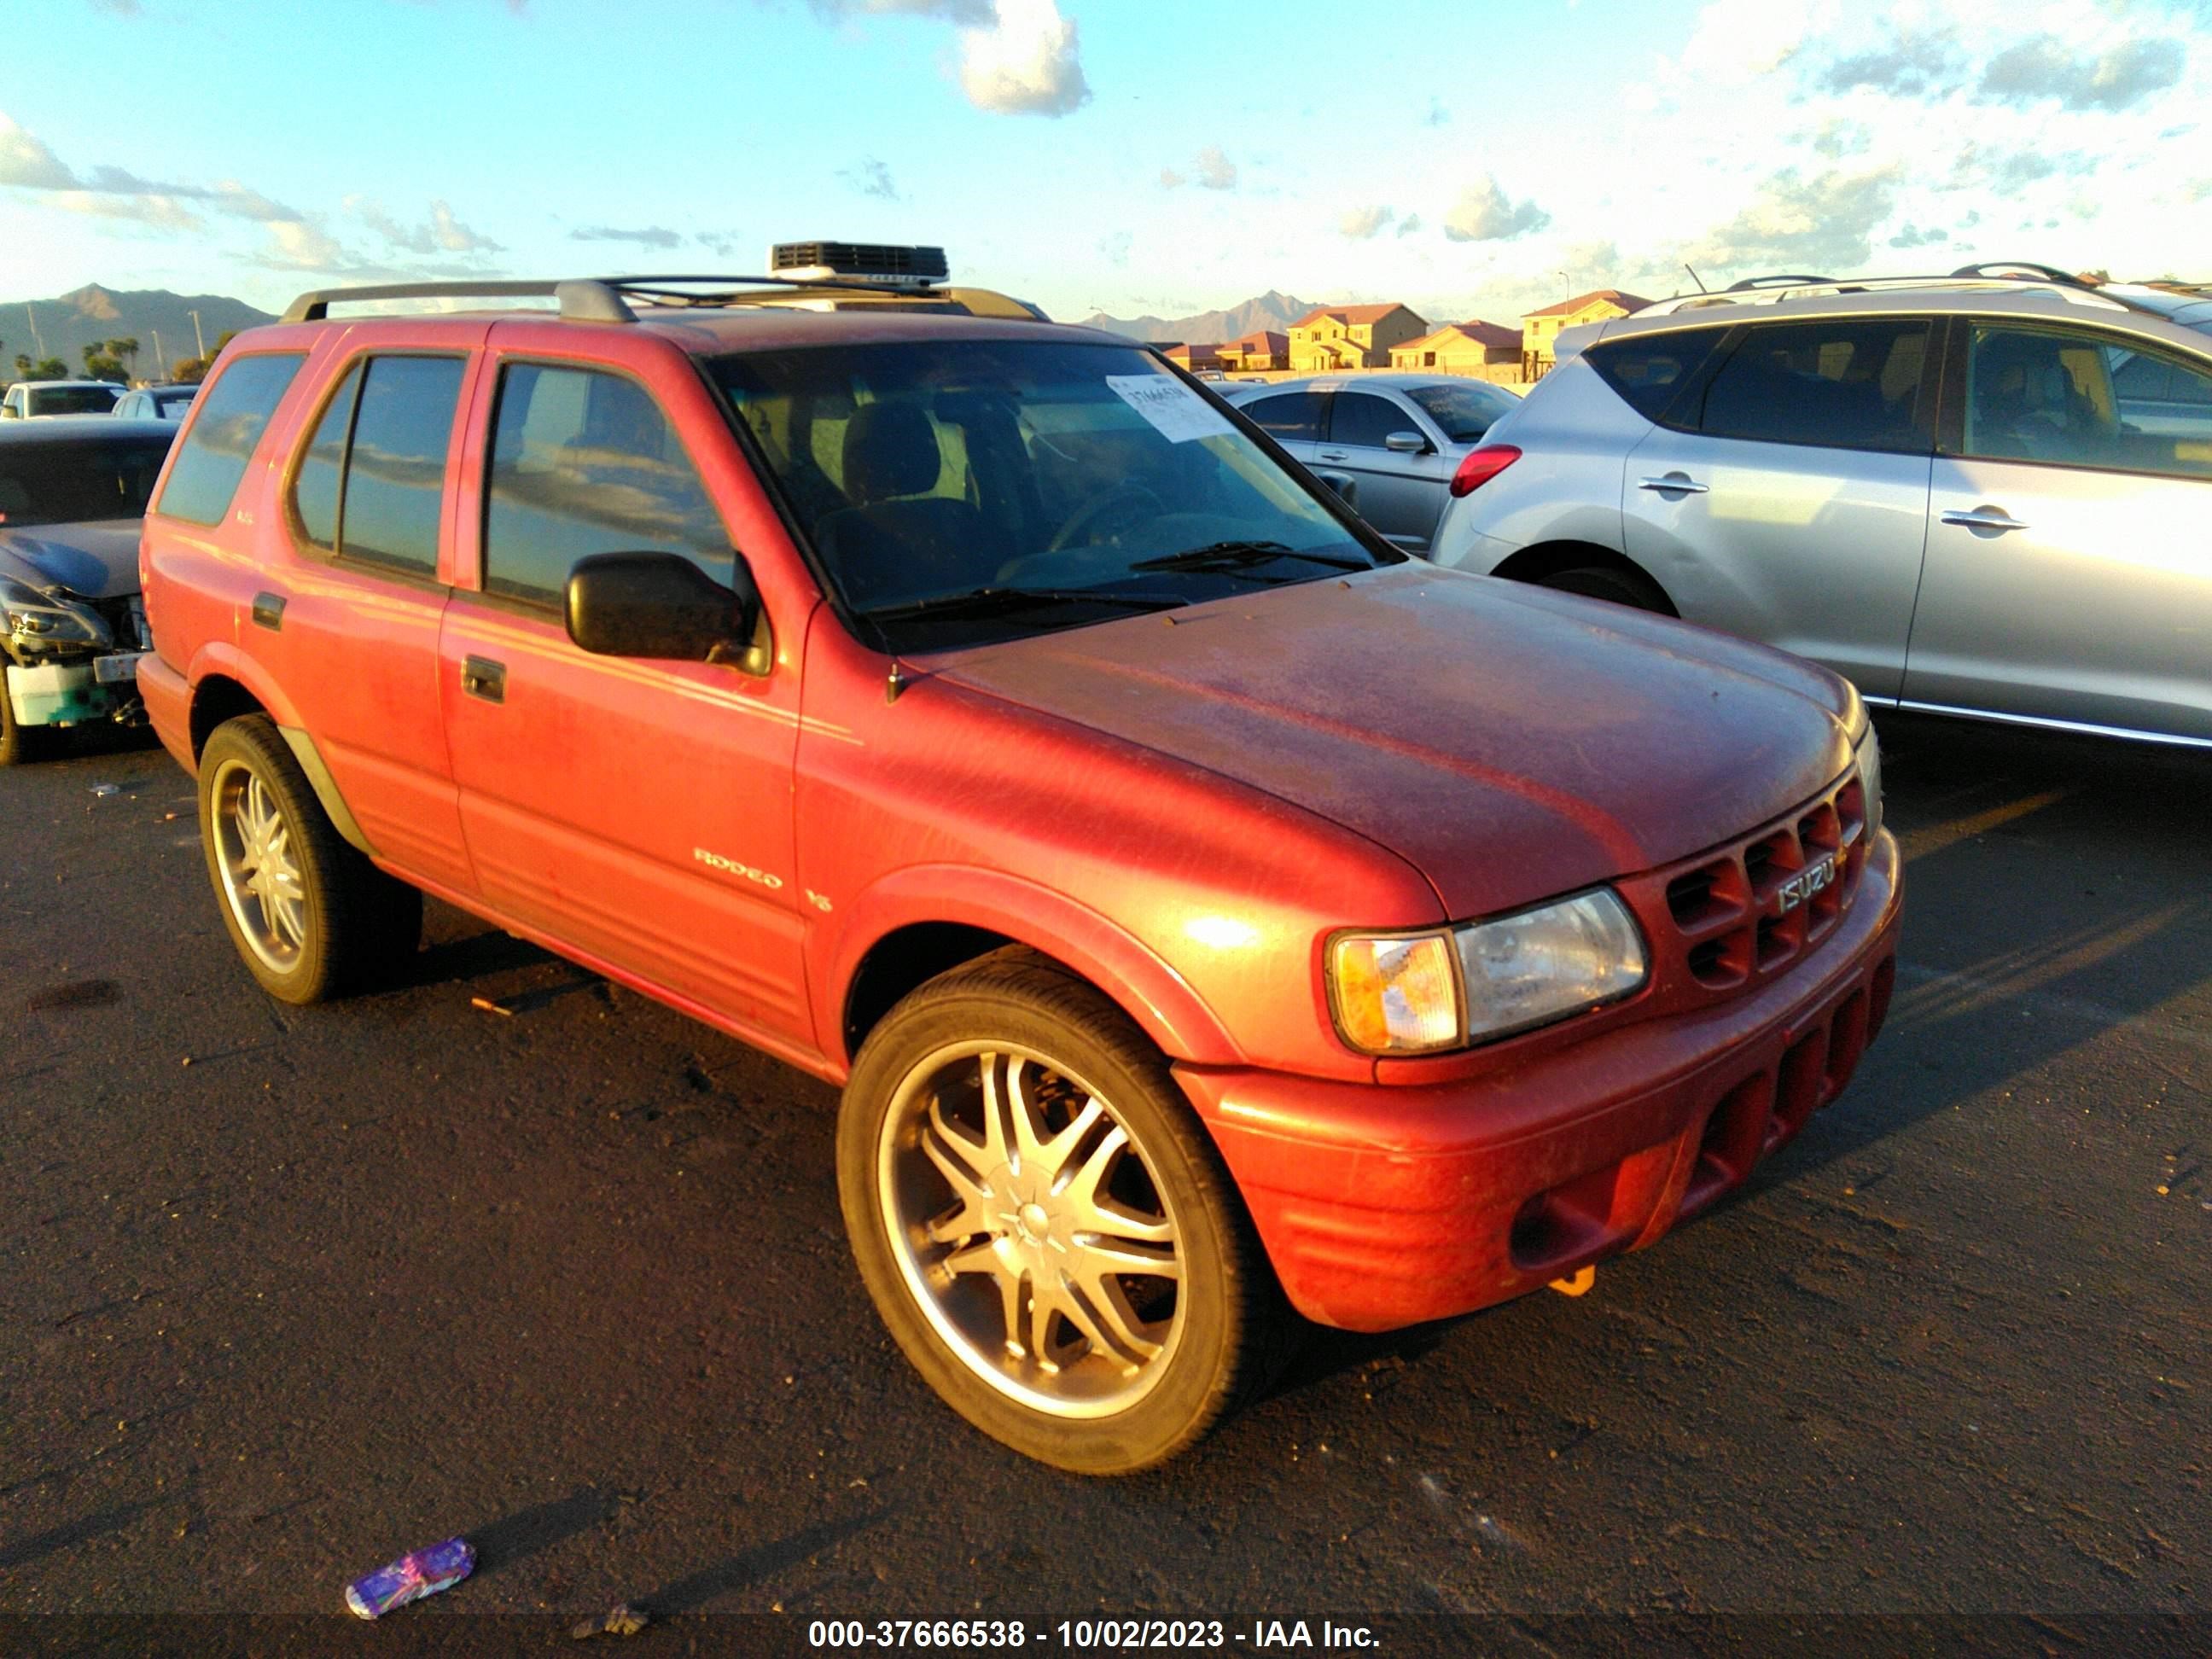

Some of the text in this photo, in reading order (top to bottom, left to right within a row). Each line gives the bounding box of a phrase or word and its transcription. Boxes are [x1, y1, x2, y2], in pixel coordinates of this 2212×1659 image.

[693, 847, 834, 913] RODEO V6
[1778, 857, 1835, 915] ISUZU
